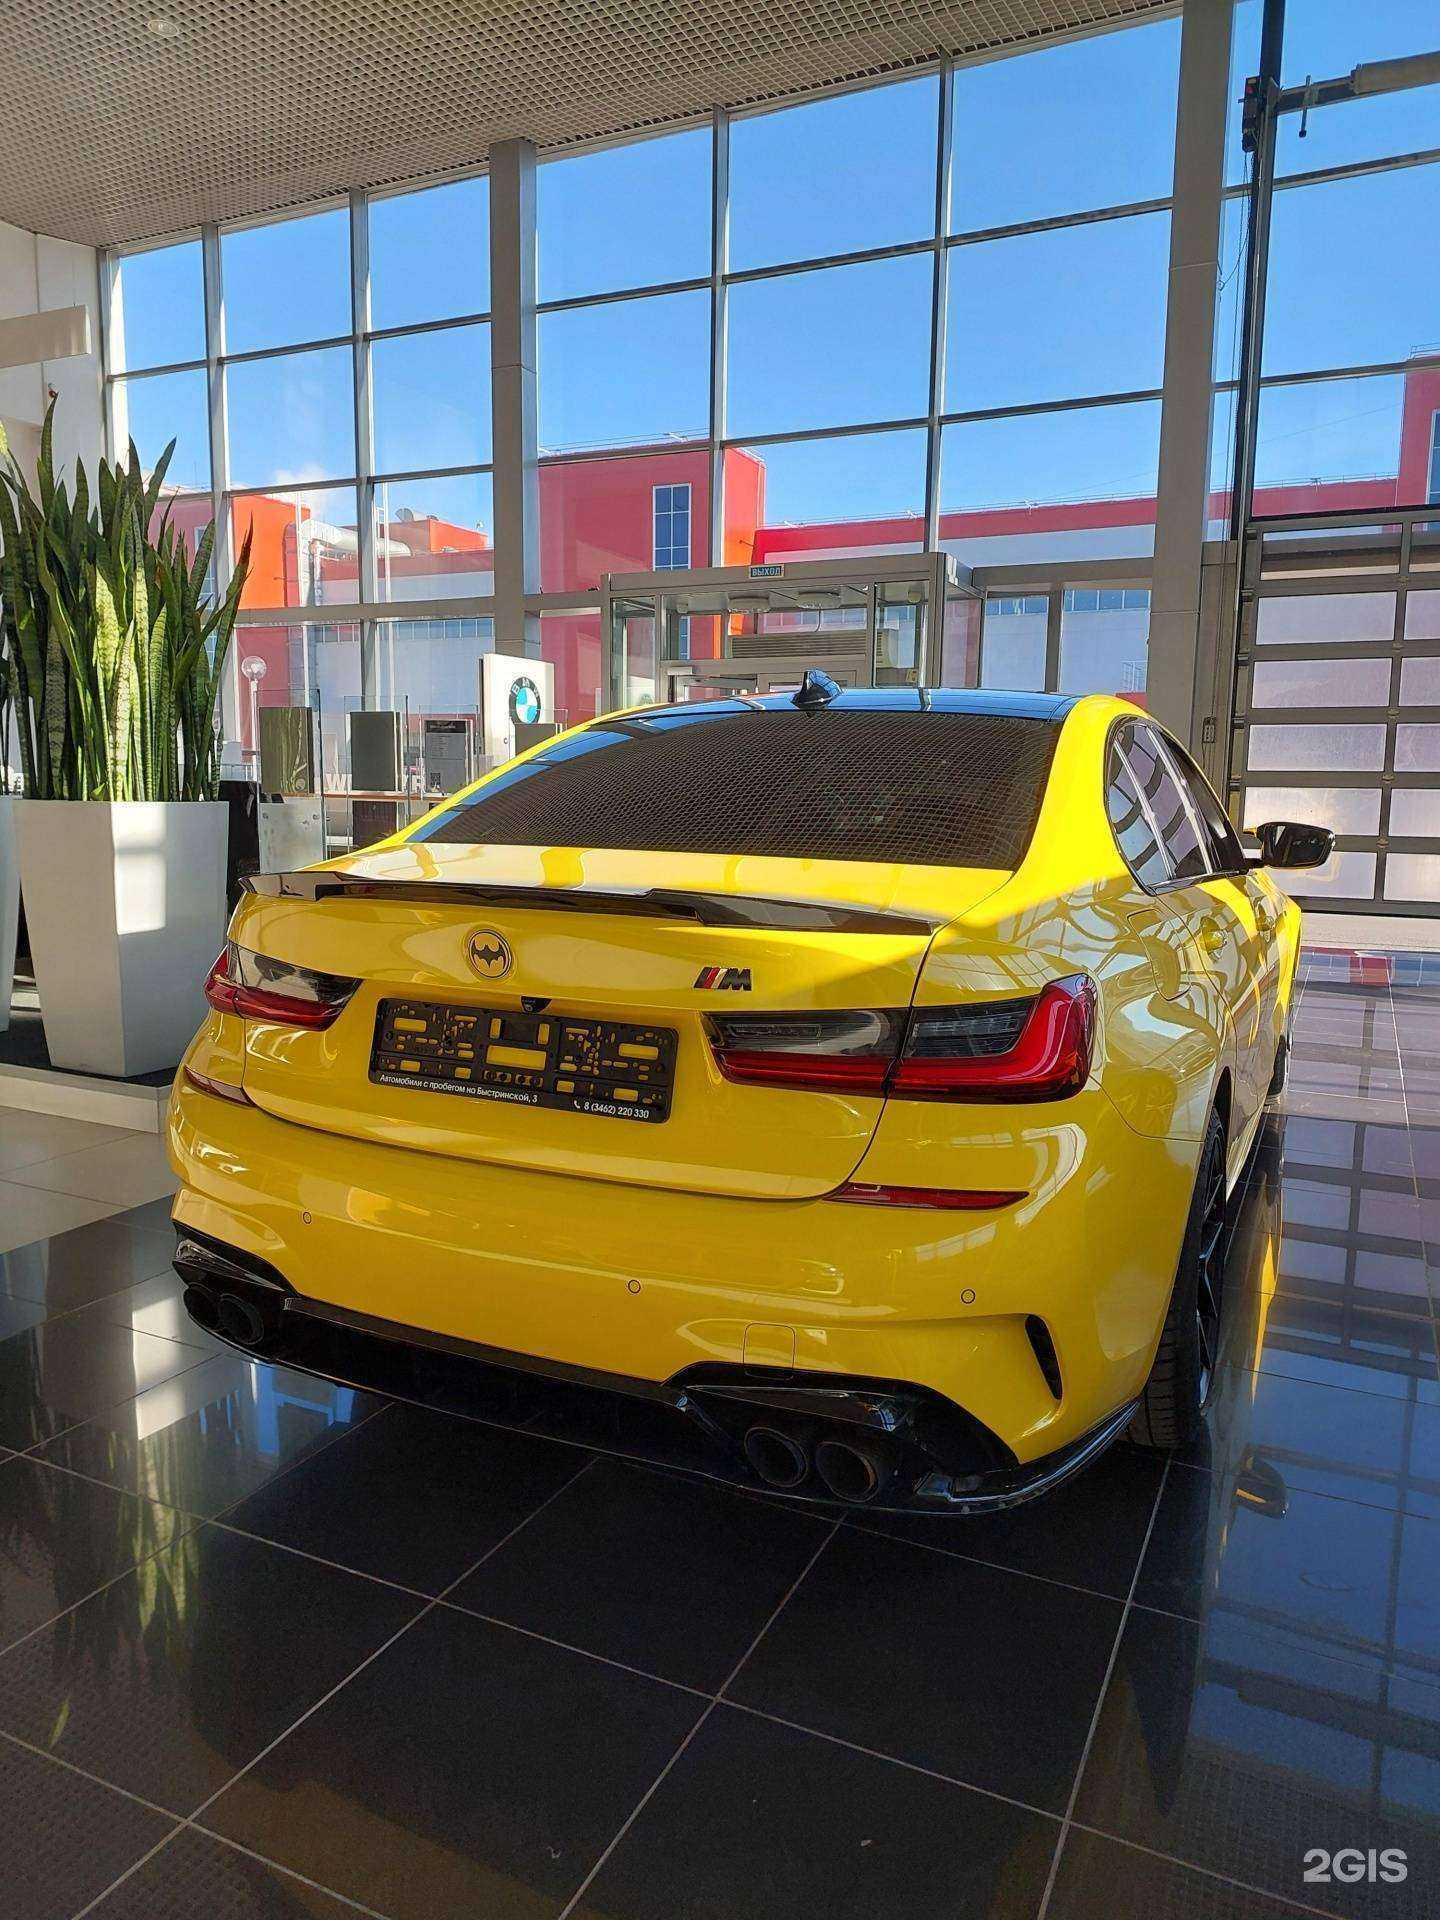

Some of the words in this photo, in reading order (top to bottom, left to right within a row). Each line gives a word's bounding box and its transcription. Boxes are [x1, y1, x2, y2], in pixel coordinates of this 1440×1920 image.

[752, 567, 781, 576] ВЫХОД
[511, 677, 539, 698] BMW
[380, 1074, 422, 1087] Автомобили
[429, 1081, 465, 1093] пробегом
[477, 1087, 531, 1103] Быстринской,
[532, 1095, 538, 1103] 3
[584, 1101, 590, 1110] 8
[591, 1102, 616, 1115] (3462)
[617, 1106, 633, 1116] 220
[633, 1108, 649, 1119] 330
